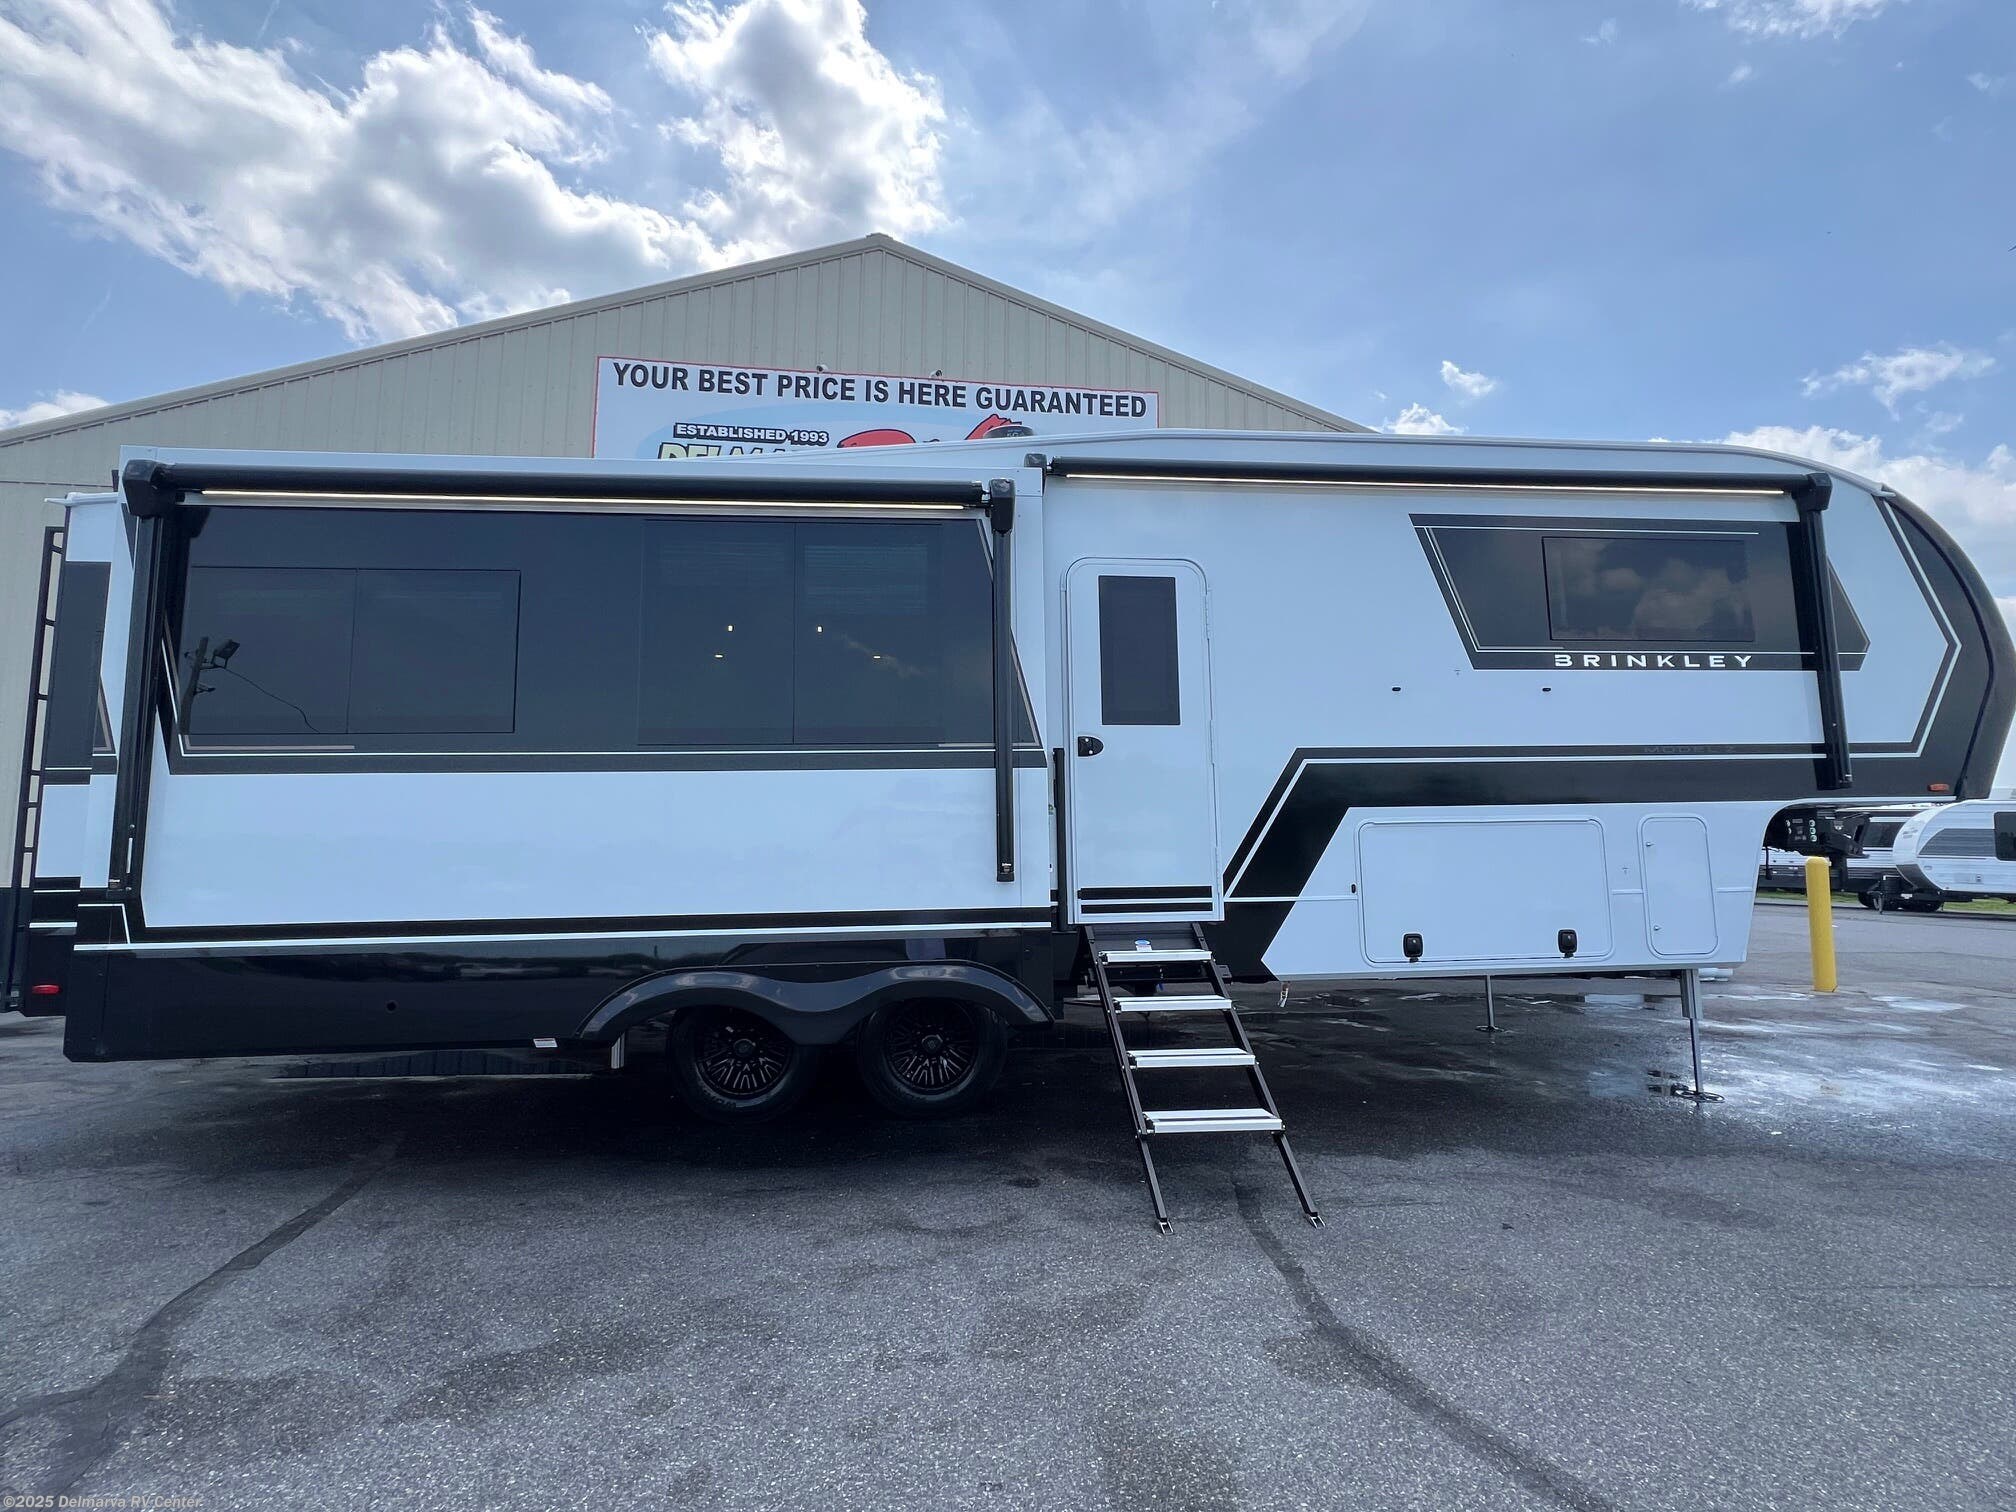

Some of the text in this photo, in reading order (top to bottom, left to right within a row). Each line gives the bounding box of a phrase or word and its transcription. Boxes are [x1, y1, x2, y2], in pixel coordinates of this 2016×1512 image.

[613, 362, 1147, 418] YOUR BEST PRICE IS HERE GUARANTEED
[675, 424, 829, 444] ESTABLISHED 1993
[1554, 654, 1752, 668] BRINKLEY
[1643, 745, 1719, 754] MODEL
